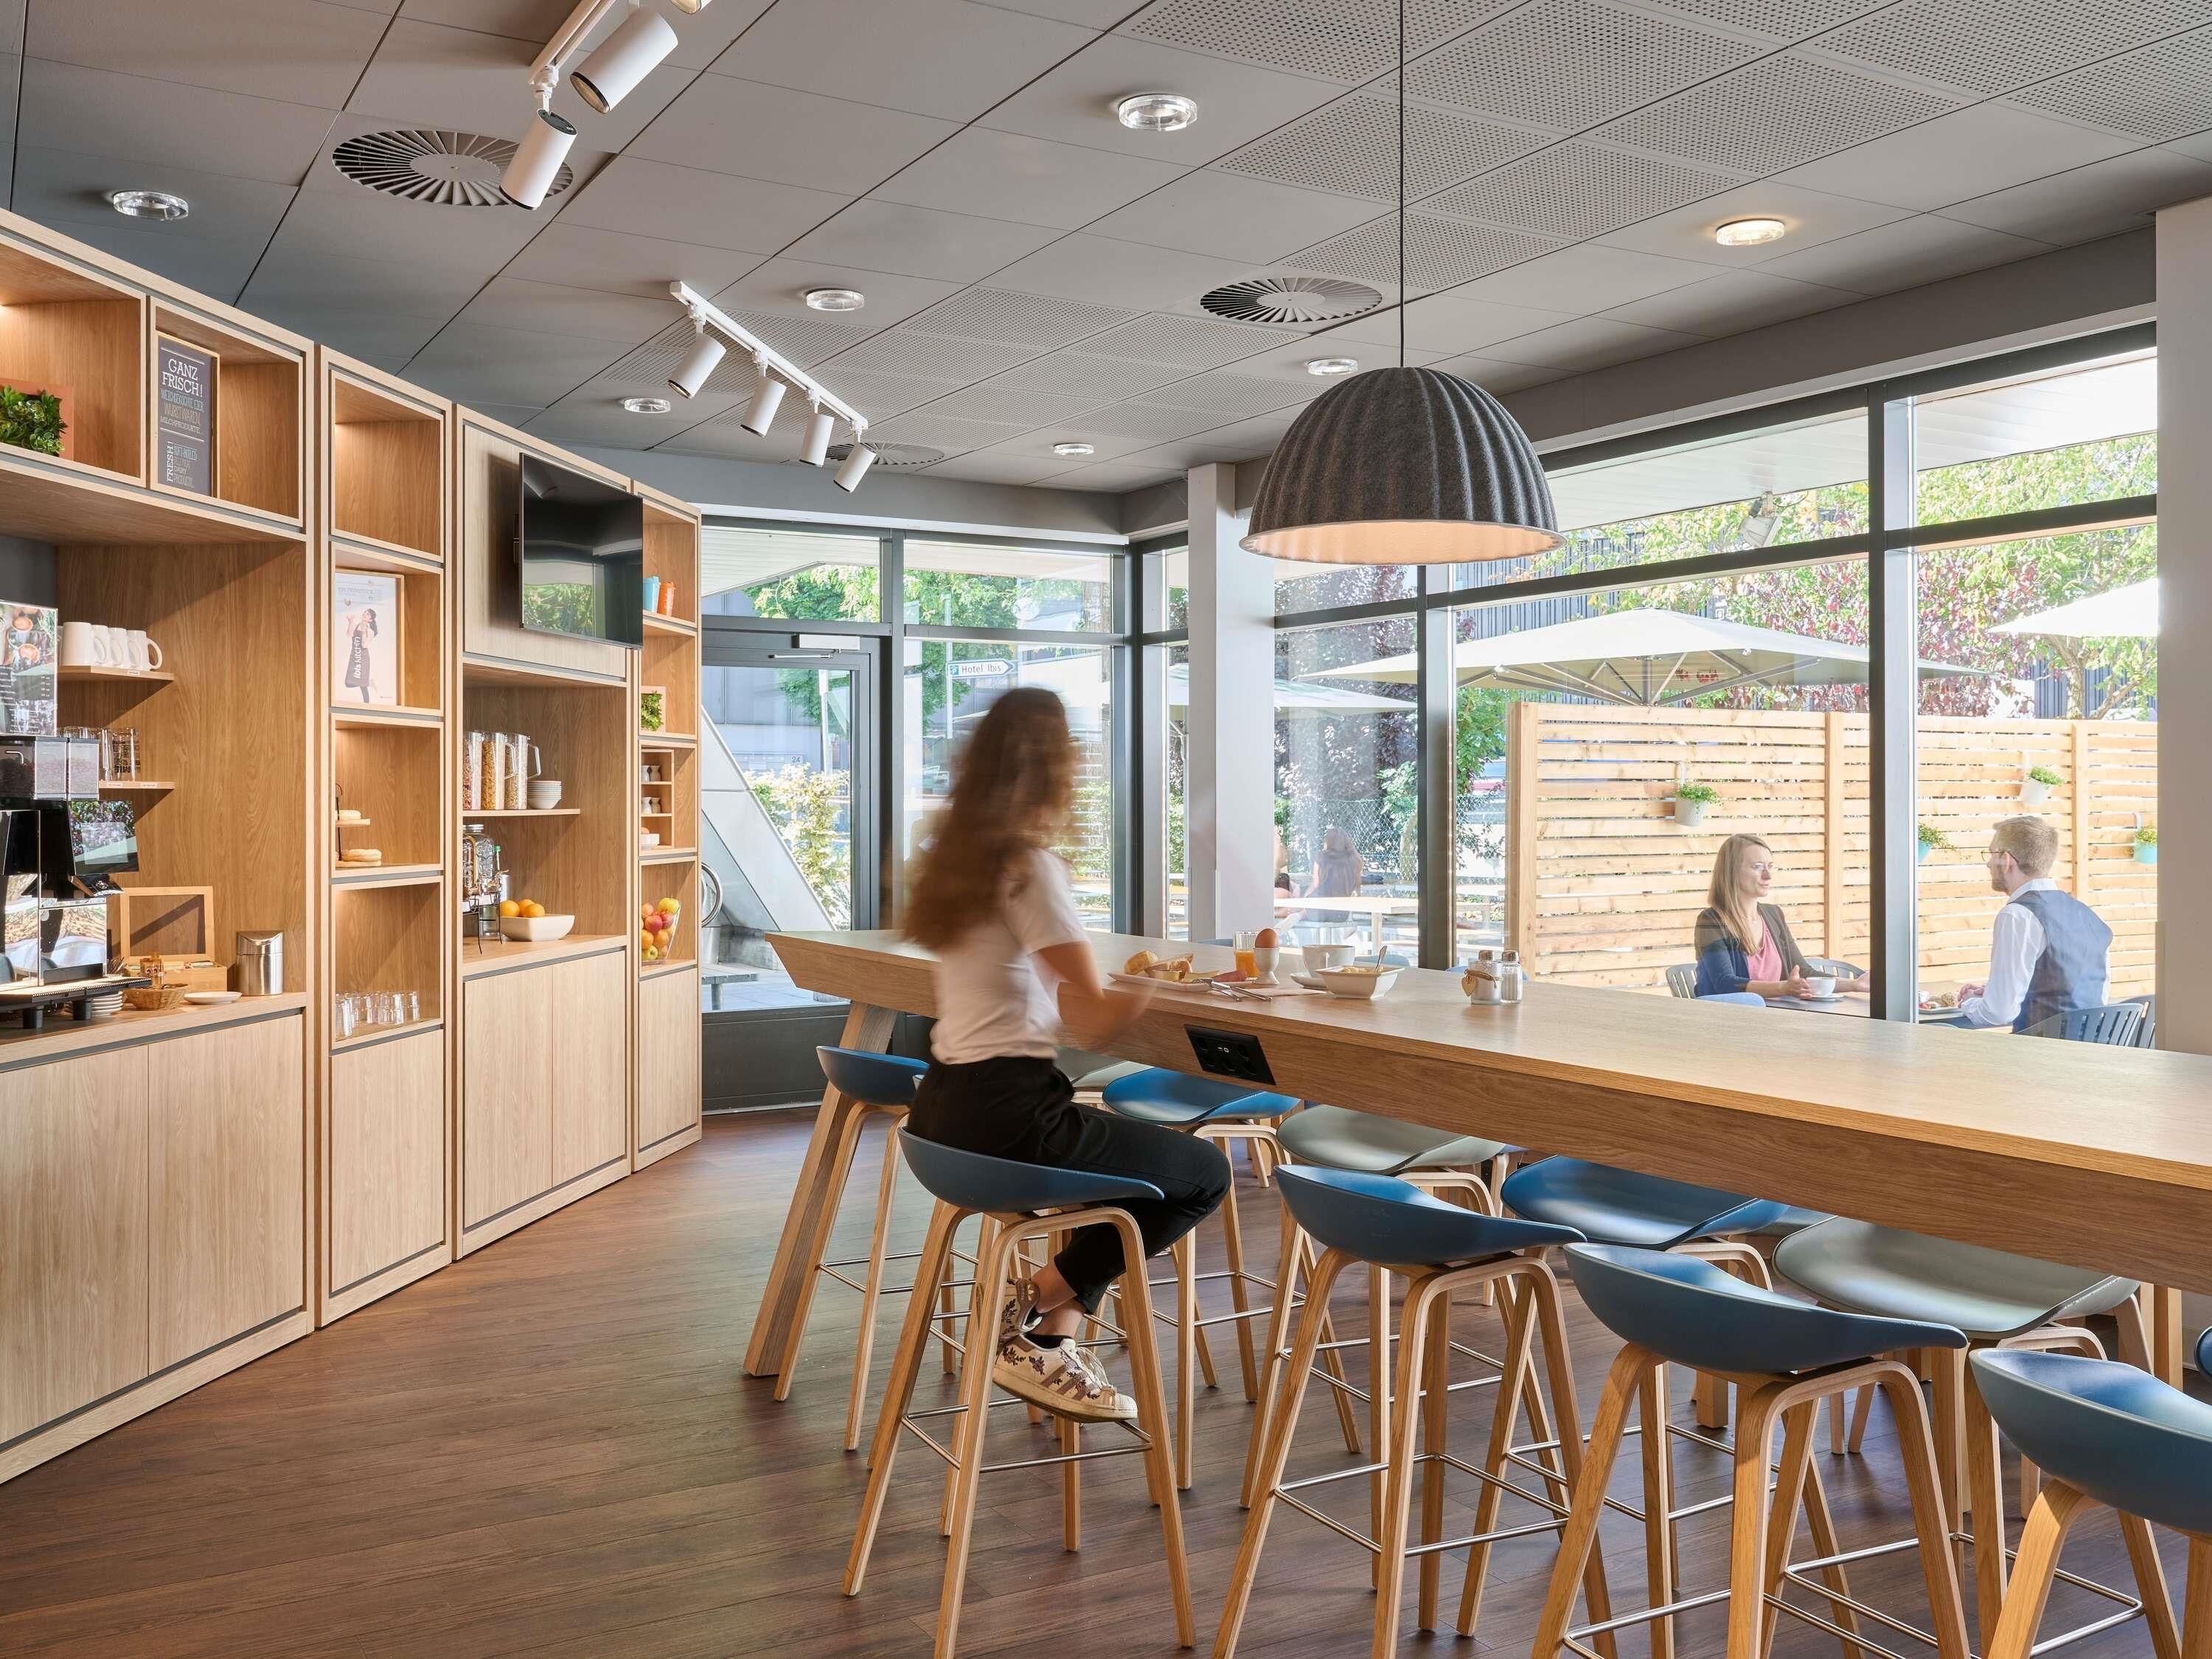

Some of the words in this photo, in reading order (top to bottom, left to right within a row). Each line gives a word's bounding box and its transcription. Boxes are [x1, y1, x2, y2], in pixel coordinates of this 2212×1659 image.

[168, 358, 198, 380] GANZ
[161, 371, 203, 397] FRISCH!
[961, 663, 983, 673] Hotel
[987, 663, 1002, 672] Ibis
